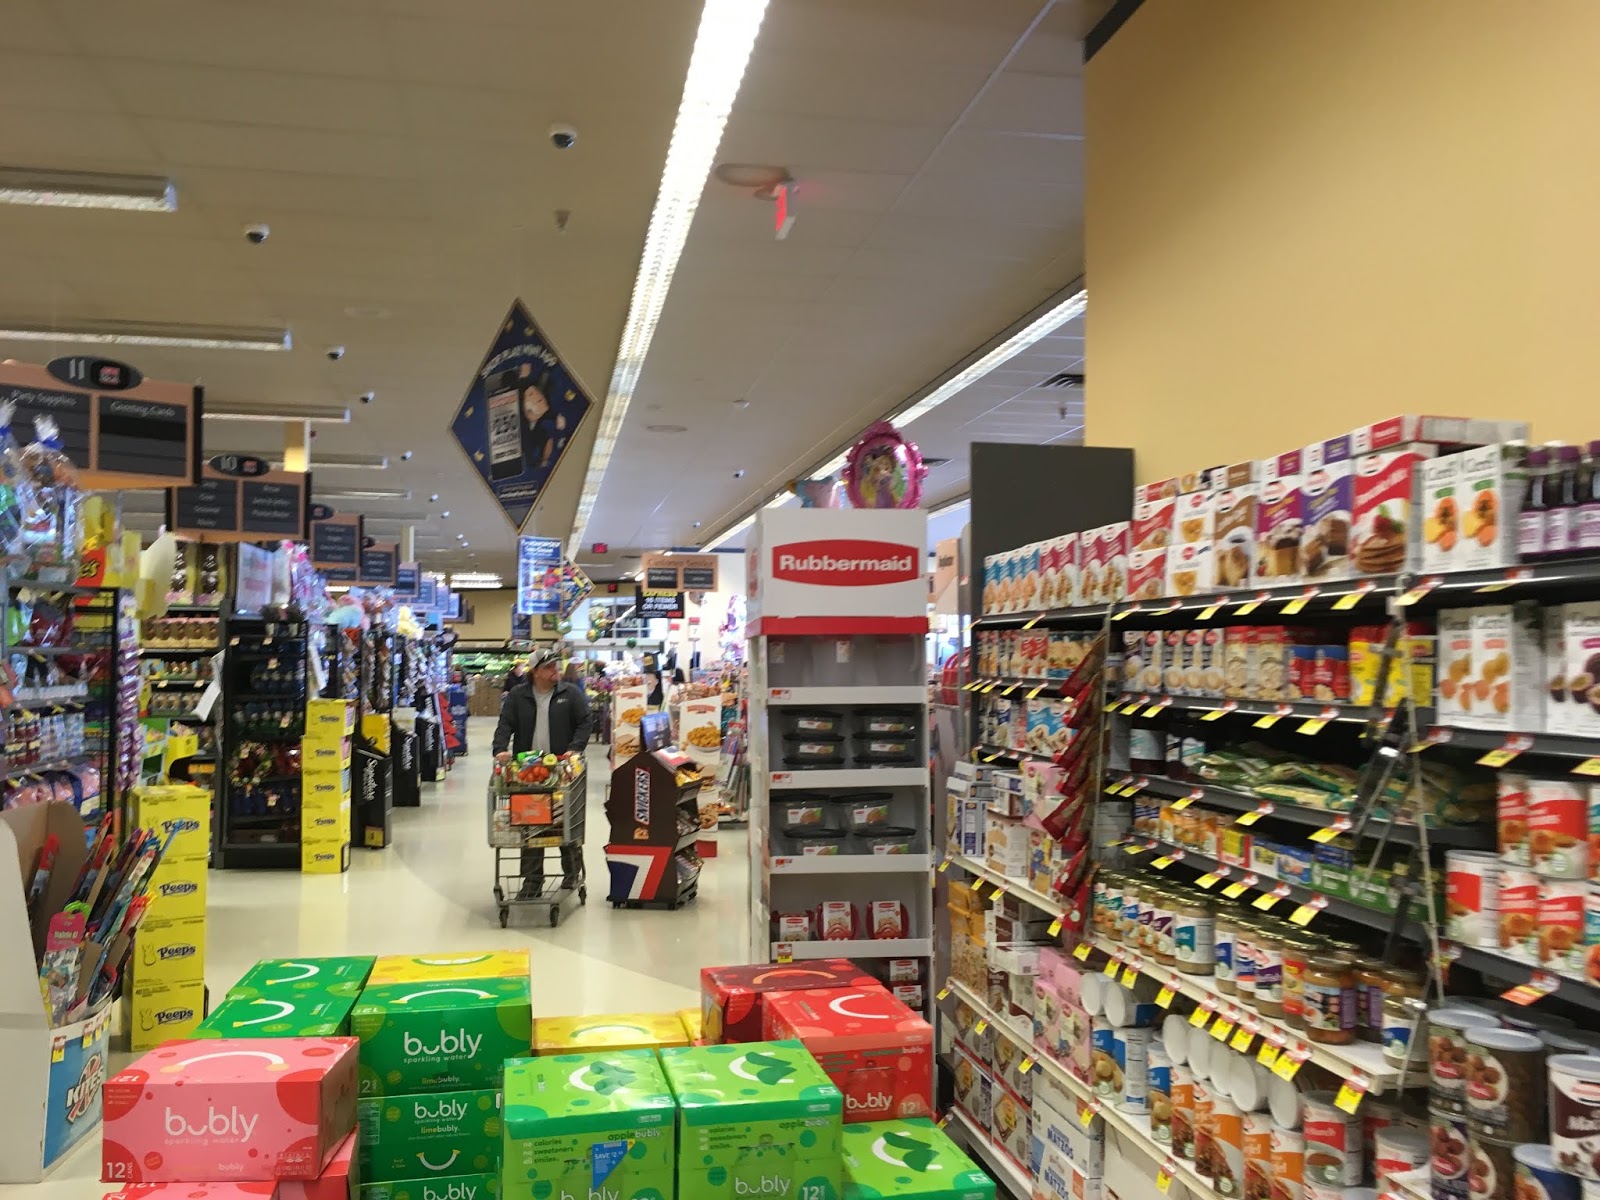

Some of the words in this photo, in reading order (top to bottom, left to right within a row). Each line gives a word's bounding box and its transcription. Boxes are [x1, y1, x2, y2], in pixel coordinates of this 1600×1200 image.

[69, 358, 85, 379] 11
[779, 554, 912, 572] Rubbermaid
[635, 769, 650, 823] SNICKERS
[159, 882, 198, 898] Peeps
[157, 944, 196, 960] Peeps
[154, 1009, 194, 1025] Peeps
[404, 1028, 483, 1059] bubly
[404, 1053, 441, 1065] sparkling
[443, 1053, 467, 1061] water
[414, 1099, 468, 1120] bubly
[846, 1091, 893, 1111] bubly
[165, 1106, 259, 1142] bubly
[534, 1138, 562, 1147] calories
[534, 1147, 574, 1155] sweeteners
[594, 1152, 611, 1160] SAVE
[106, 1162, 126, 1179] 12
[423, 1183, 477, 1200] bubly
[735, 1175, 791, 1196] bubly
[802, 1186, 819, 1200] 12
